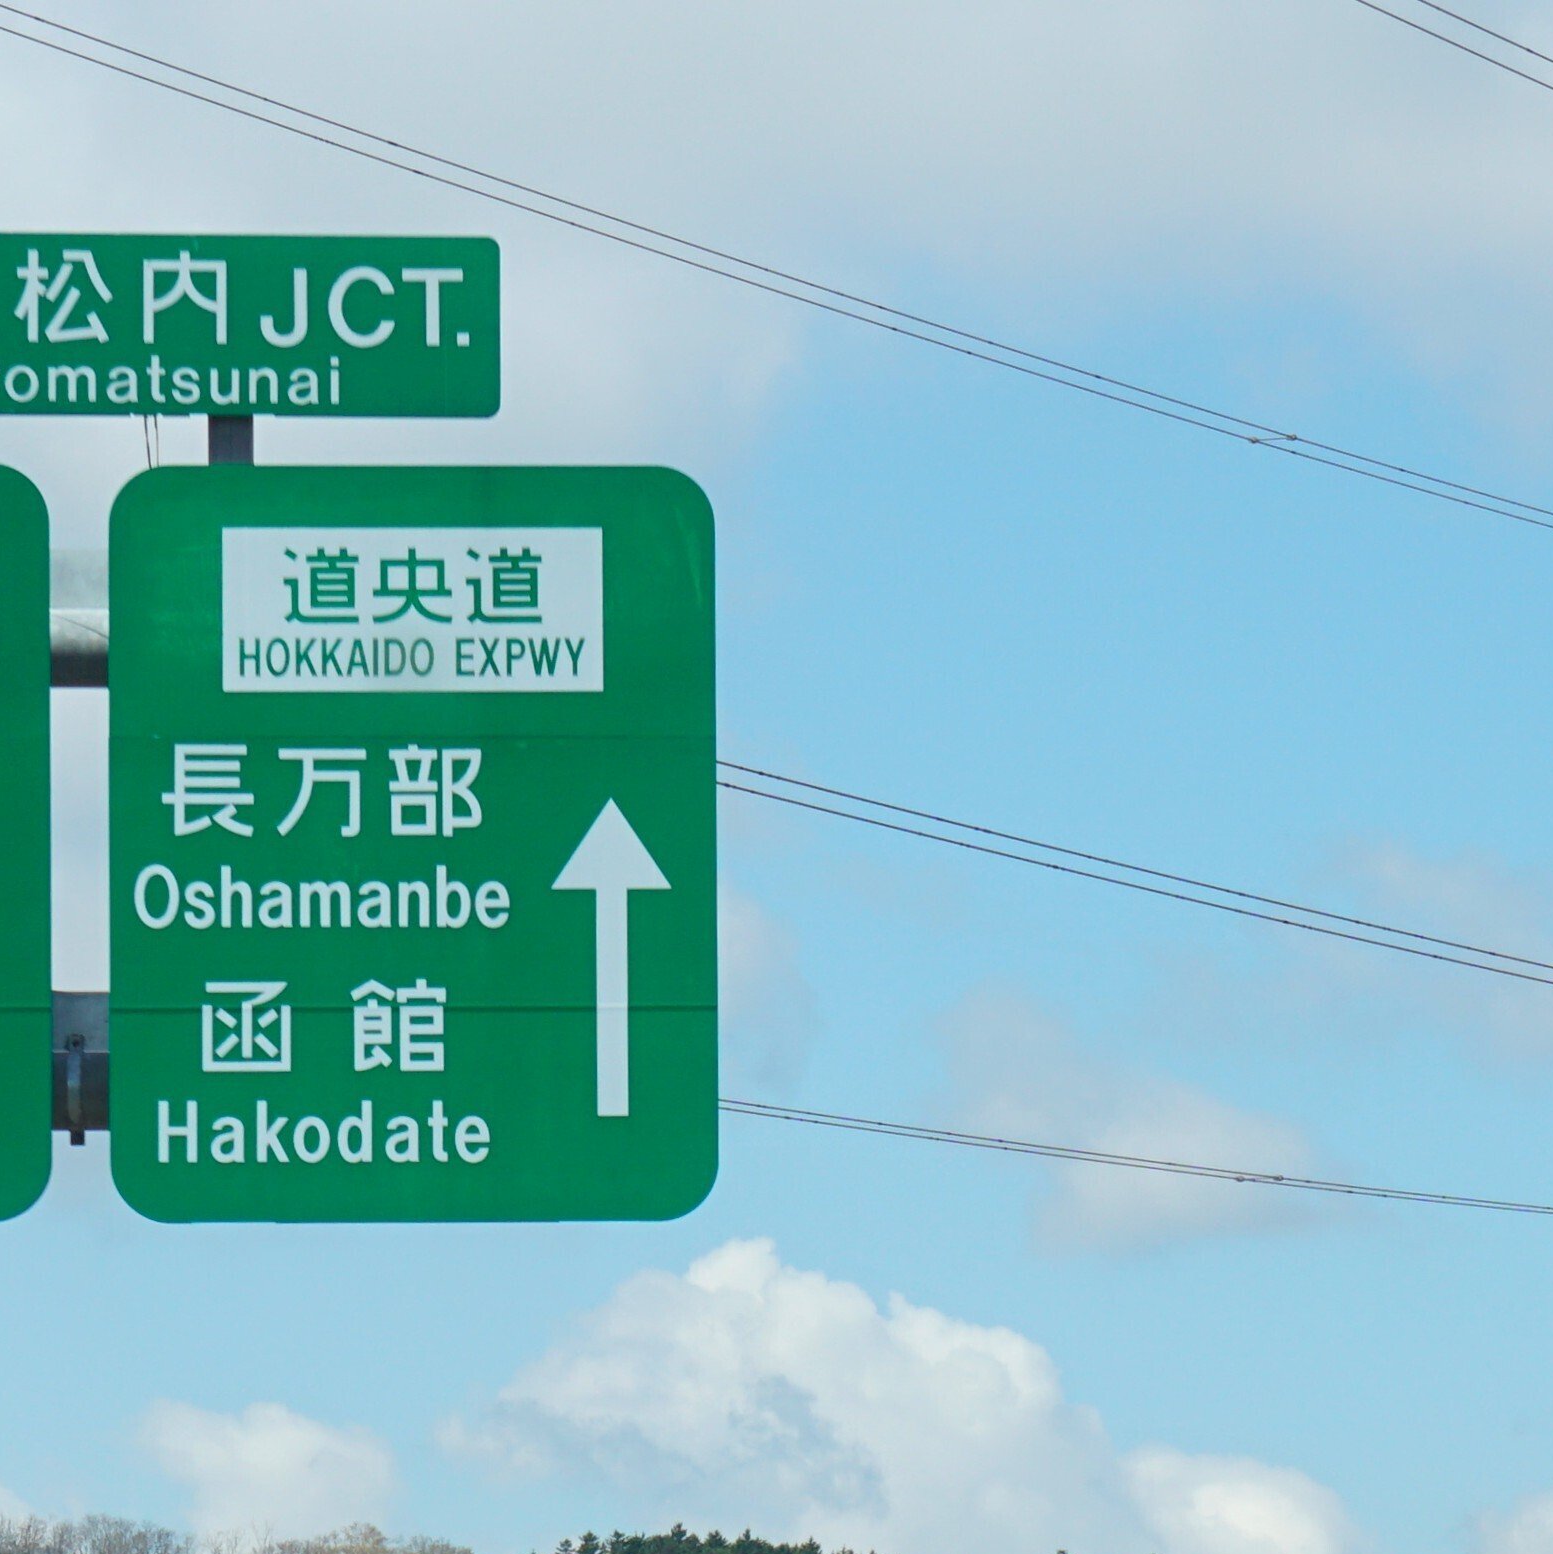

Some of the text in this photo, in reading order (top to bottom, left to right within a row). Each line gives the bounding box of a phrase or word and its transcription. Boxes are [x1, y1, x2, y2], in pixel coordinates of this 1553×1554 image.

[283, 547, 543, 625] 道央道
[238, 637, 585, 678] HOKKAIDO EXPWY
[161, 743, 483, 838] 長万部
[133, 863, 511, 930] Oshamanbe
[201, 978, 447, 1073] 函館
[157, 1099, 491, 1164] Hakodate
